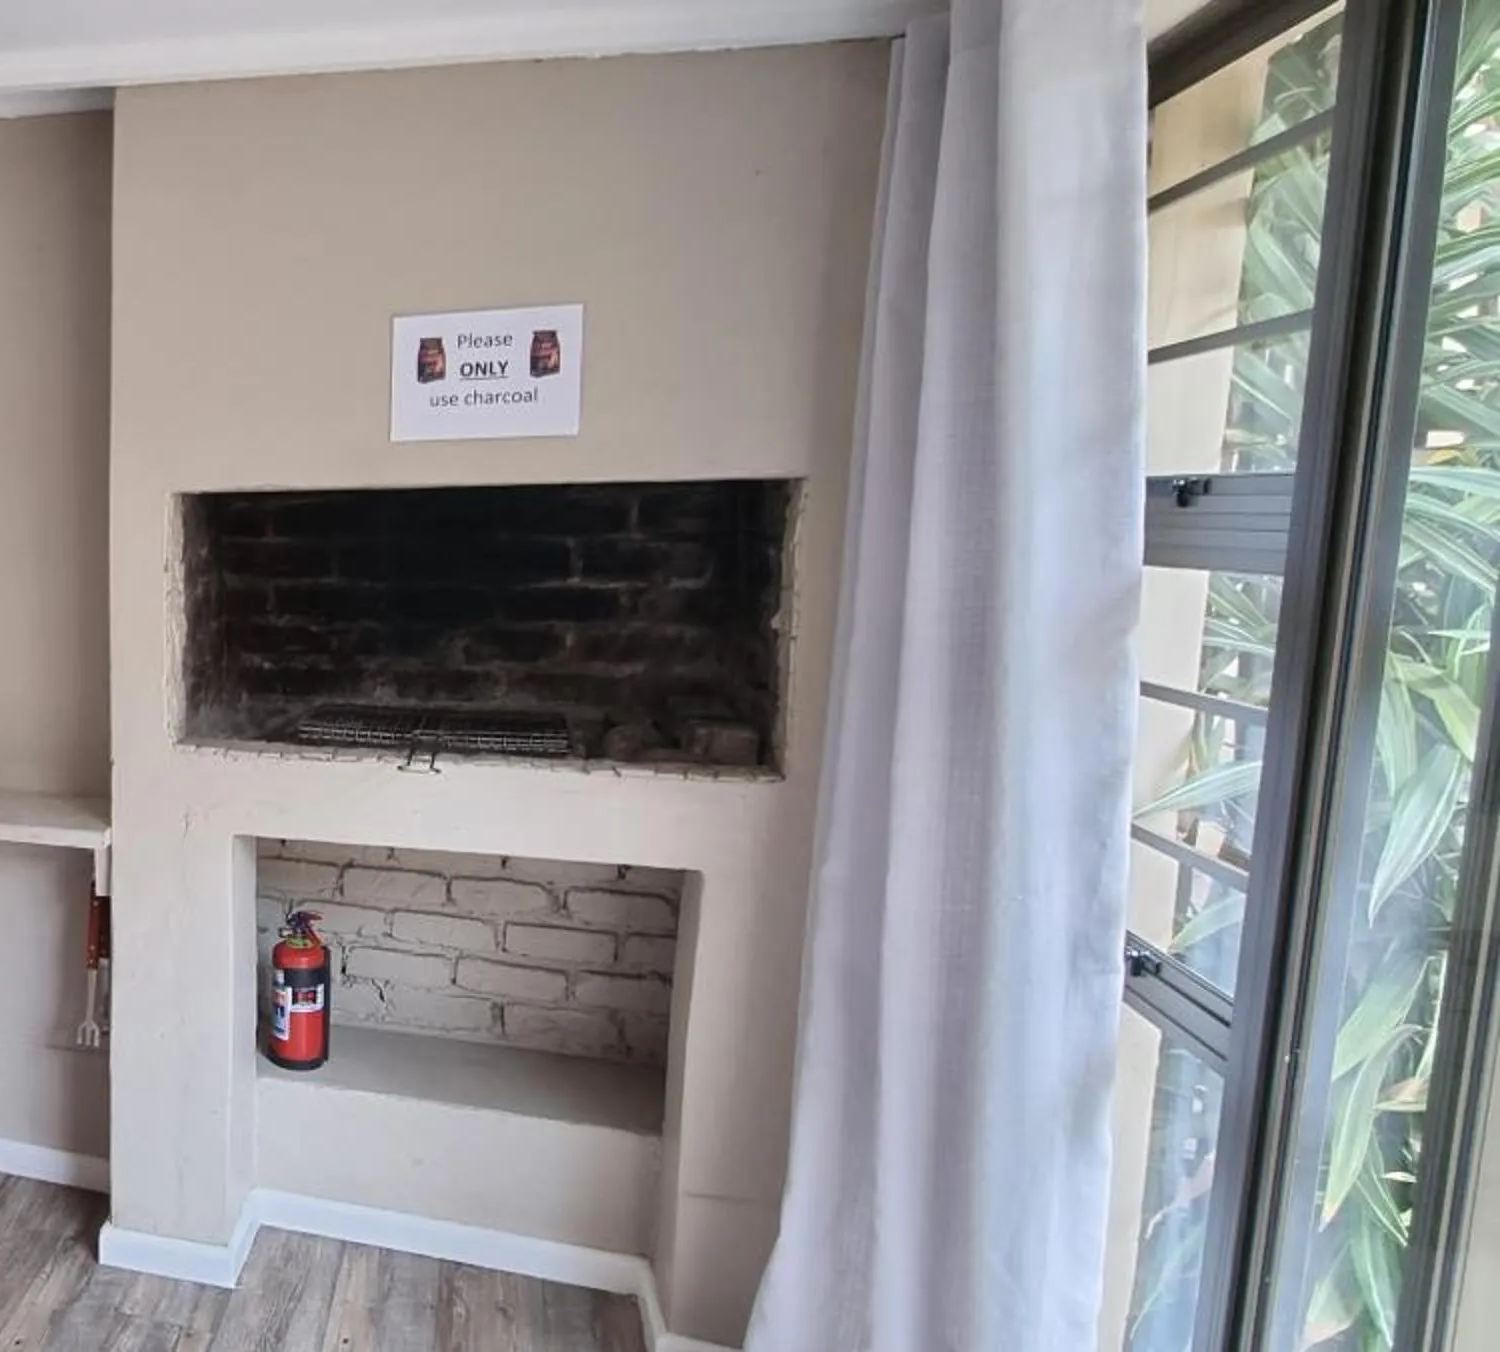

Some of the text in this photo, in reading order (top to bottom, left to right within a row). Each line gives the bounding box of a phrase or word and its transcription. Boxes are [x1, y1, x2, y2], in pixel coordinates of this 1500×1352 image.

[457, 332, 513, 349] Please
[459, 360, 509, 378] ONLY
[429, 387, 539, 407] use charcoal
